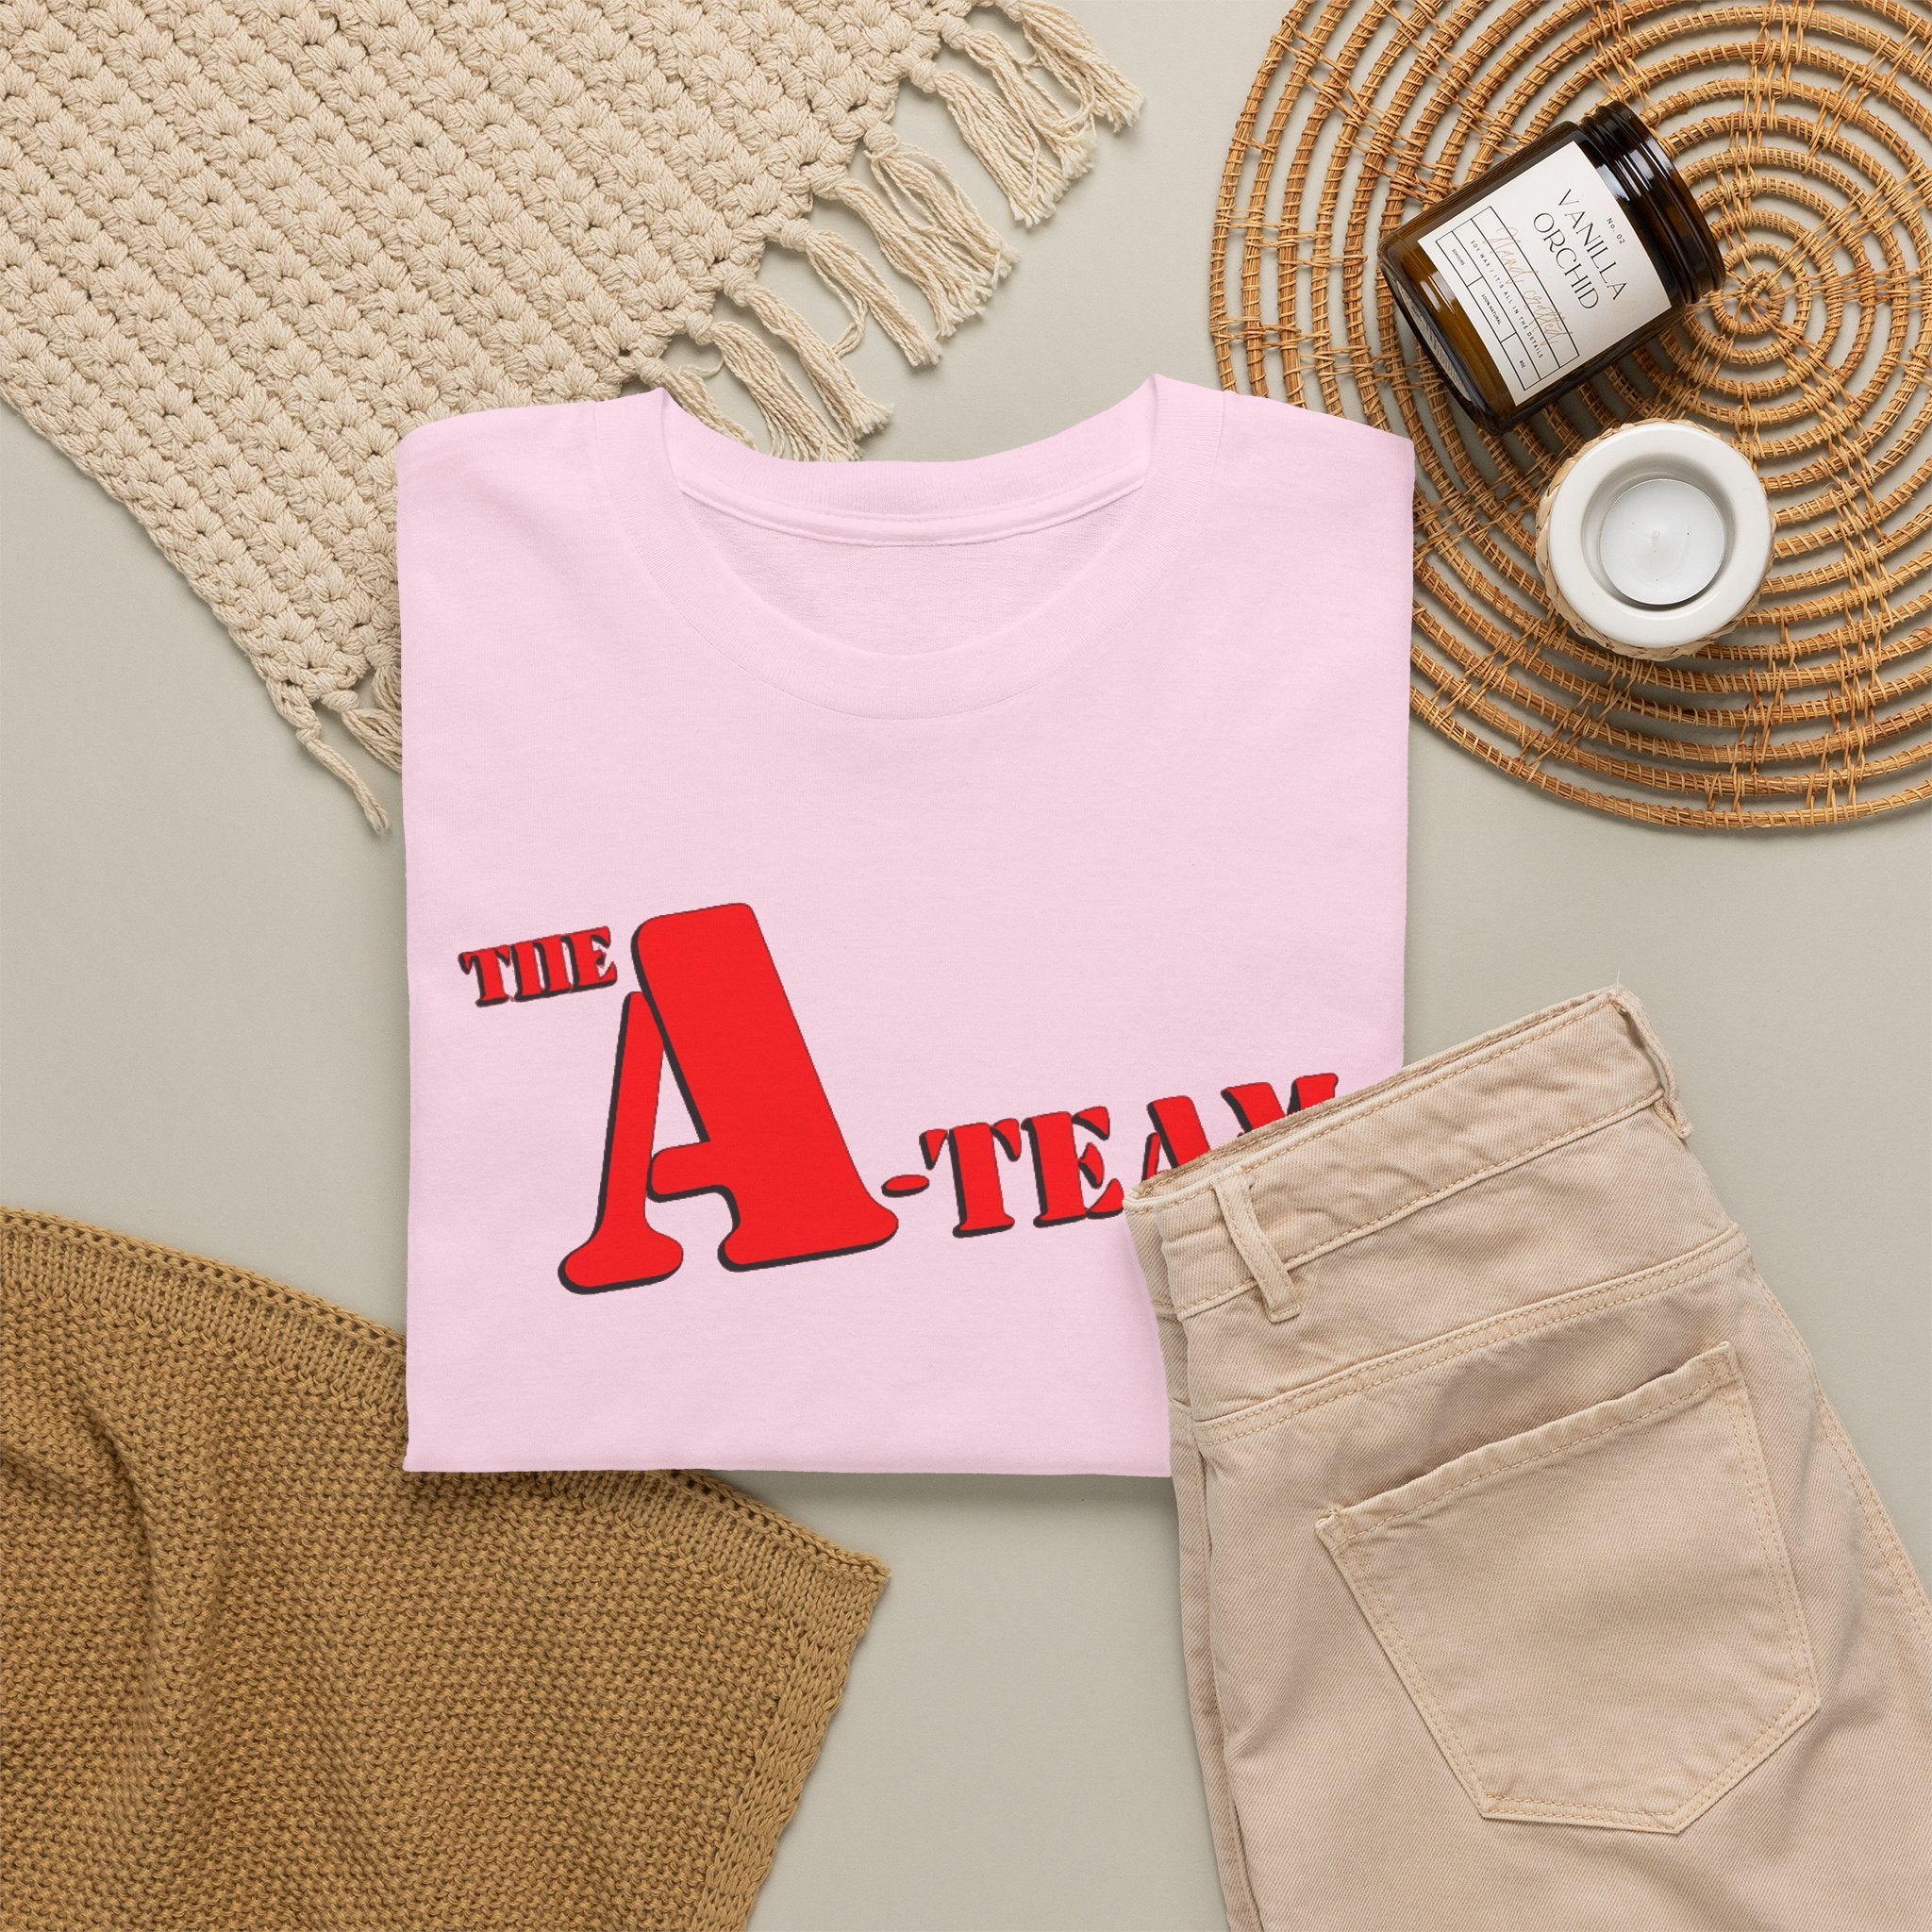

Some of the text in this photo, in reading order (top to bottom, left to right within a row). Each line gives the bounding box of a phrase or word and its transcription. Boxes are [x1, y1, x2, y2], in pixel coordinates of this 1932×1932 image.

[1533, 212, 1599, 309] ORCHID
[1557, 189, 1627, 300] VANILLA
[1606, 217, 1625, 245] No. 02
[1470, 240, 1480, 252] SOY
[1479, 253, 1491, 267] WAX
[1493, 275, 1505, 289] IT'S
[1503, 291, 1513, 304] ALL
[1512, 306, 1520, 315] IN
[1519, 316, 1528, 330] THE
[1526, 331, 1543, 358] DETAILS
[458, 925, 618, 1008] THE
